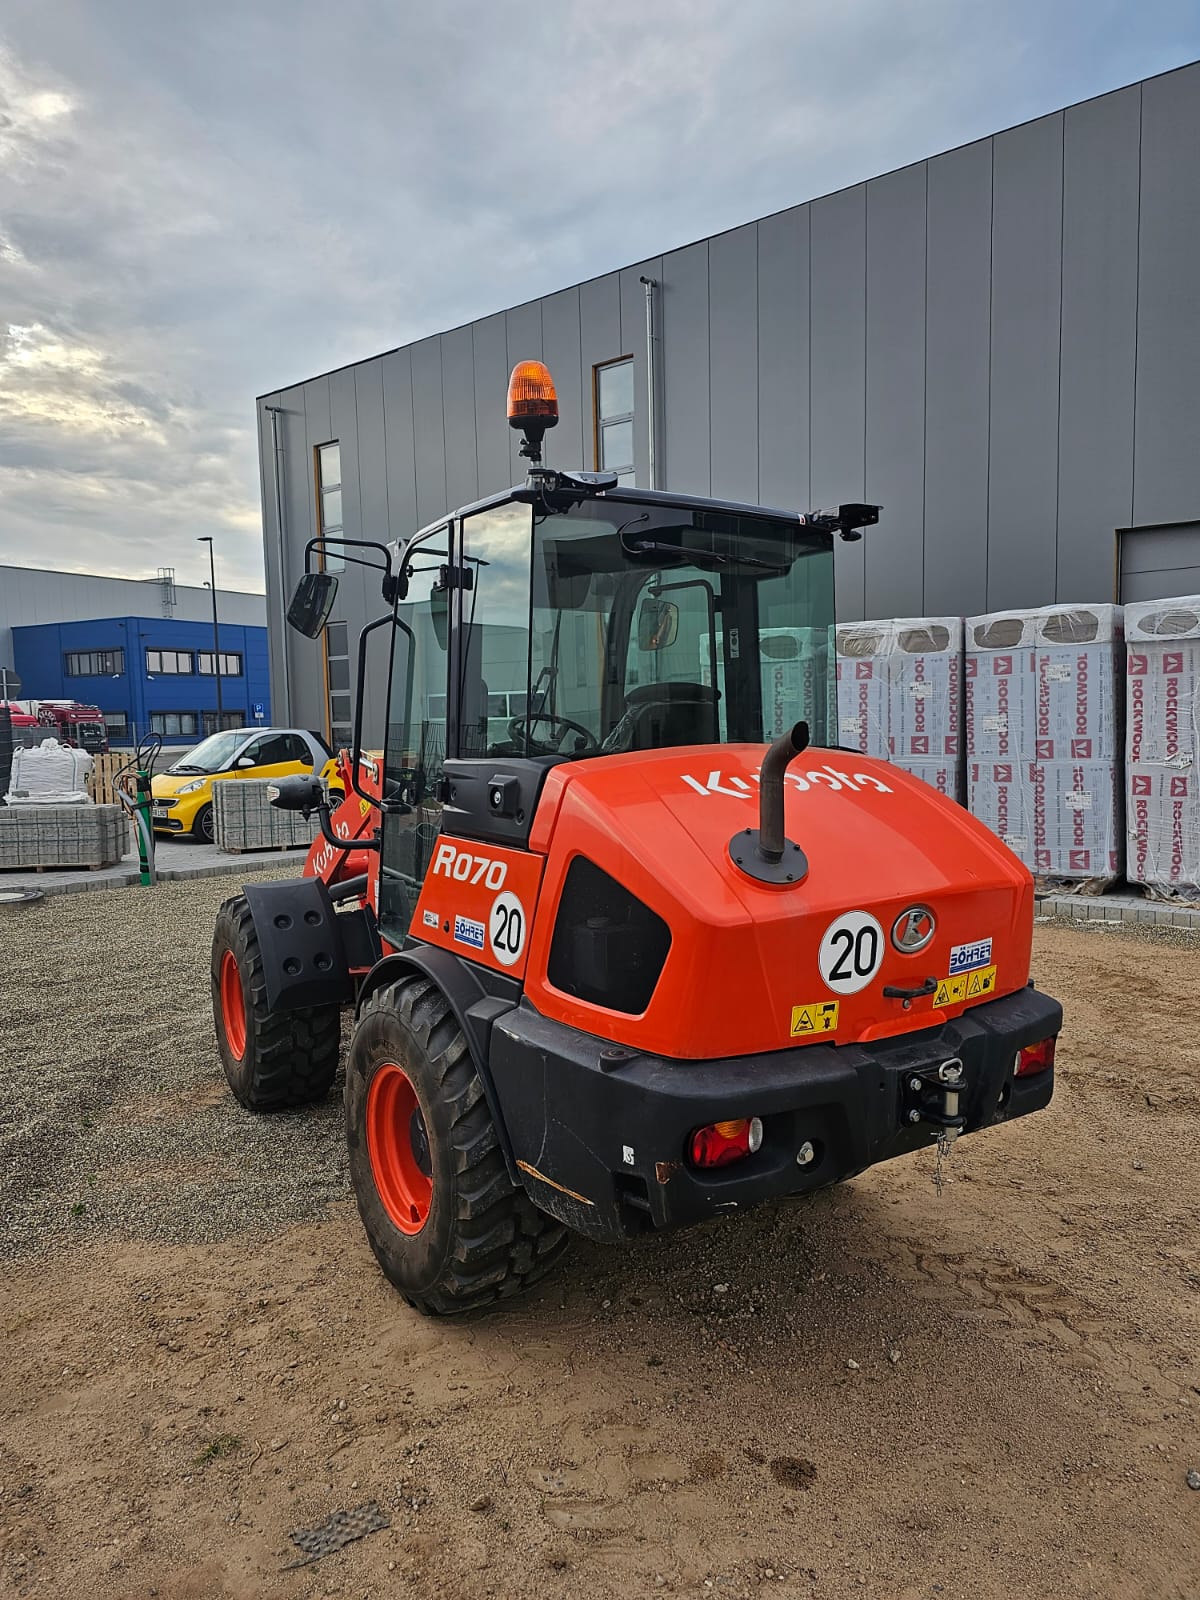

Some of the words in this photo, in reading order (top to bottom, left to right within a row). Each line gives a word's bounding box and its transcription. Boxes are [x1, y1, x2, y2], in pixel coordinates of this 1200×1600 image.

[914, 657, 925, 732] ROCKOOL
[949, 655, 958, 732] ROCKWOOL
[1076, 653, 1088, 735] ROCKWOOL
[1132, 679, 1144, 763] ROCKWOOL
[1166, 677, 1179, 758] ROCKWOO
[1073, 765, 1084, 847] ROCKOOL
[432, 844, 508, 891] R070
[493, 904, 521, 954] 20
[828, 925, 878, 981] 20
